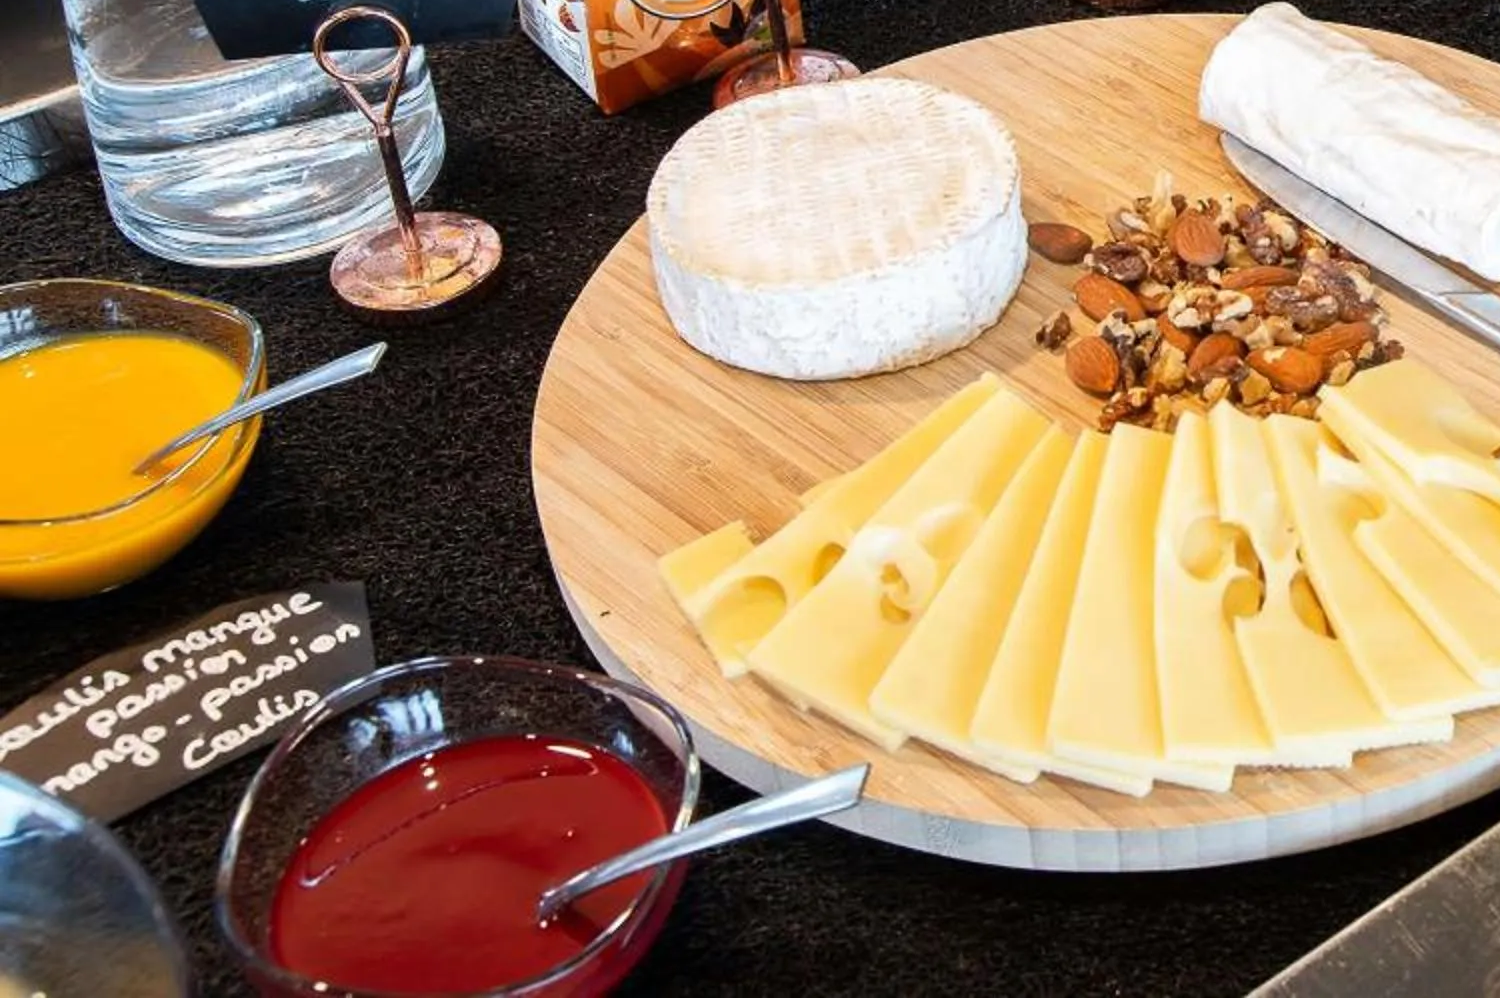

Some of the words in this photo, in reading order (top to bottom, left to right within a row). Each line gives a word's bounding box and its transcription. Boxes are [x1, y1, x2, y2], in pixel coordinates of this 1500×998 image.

[0, 669, 130, 762] oulis
[142, 591, 323, 673] mangue
[85, 649, 247, 739] passion
